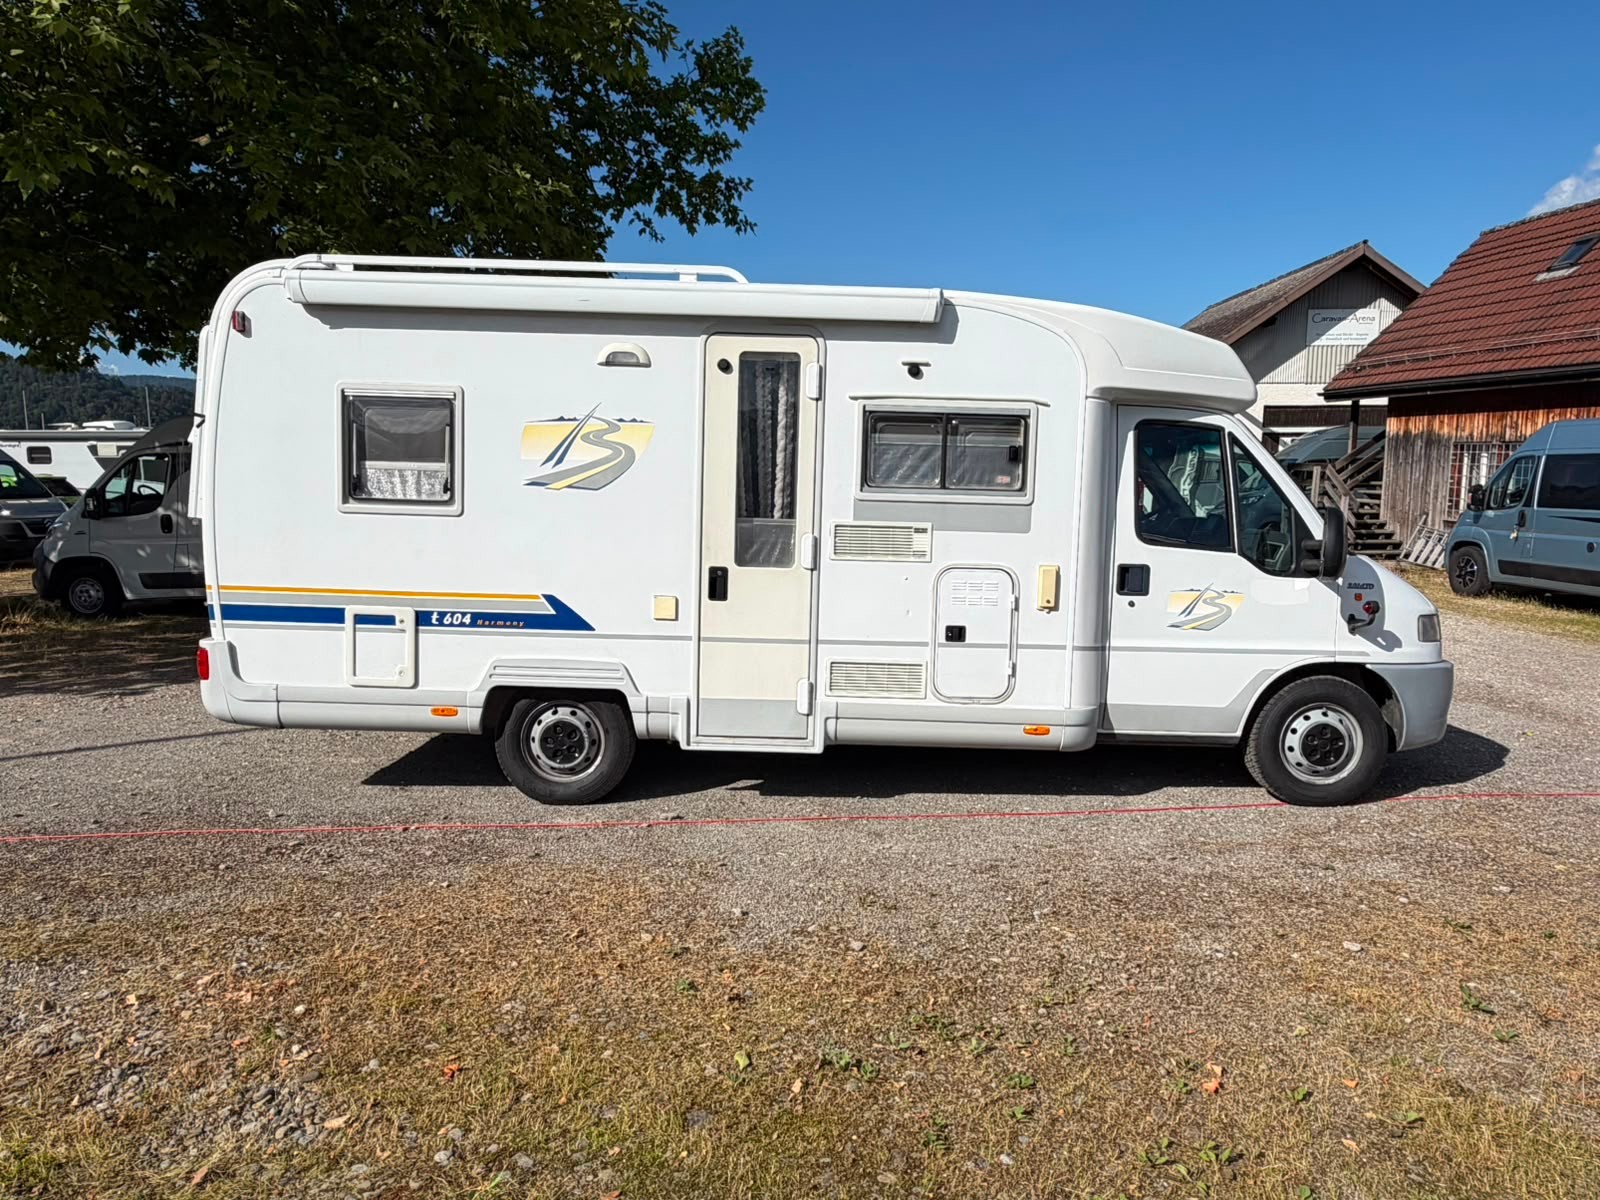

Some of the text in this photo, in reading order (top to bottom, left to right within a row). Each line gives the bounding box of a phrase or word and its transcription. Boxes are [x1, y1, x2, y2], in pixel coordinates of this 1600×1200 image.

[431, 612, 525, 628] t 604 Harmony
